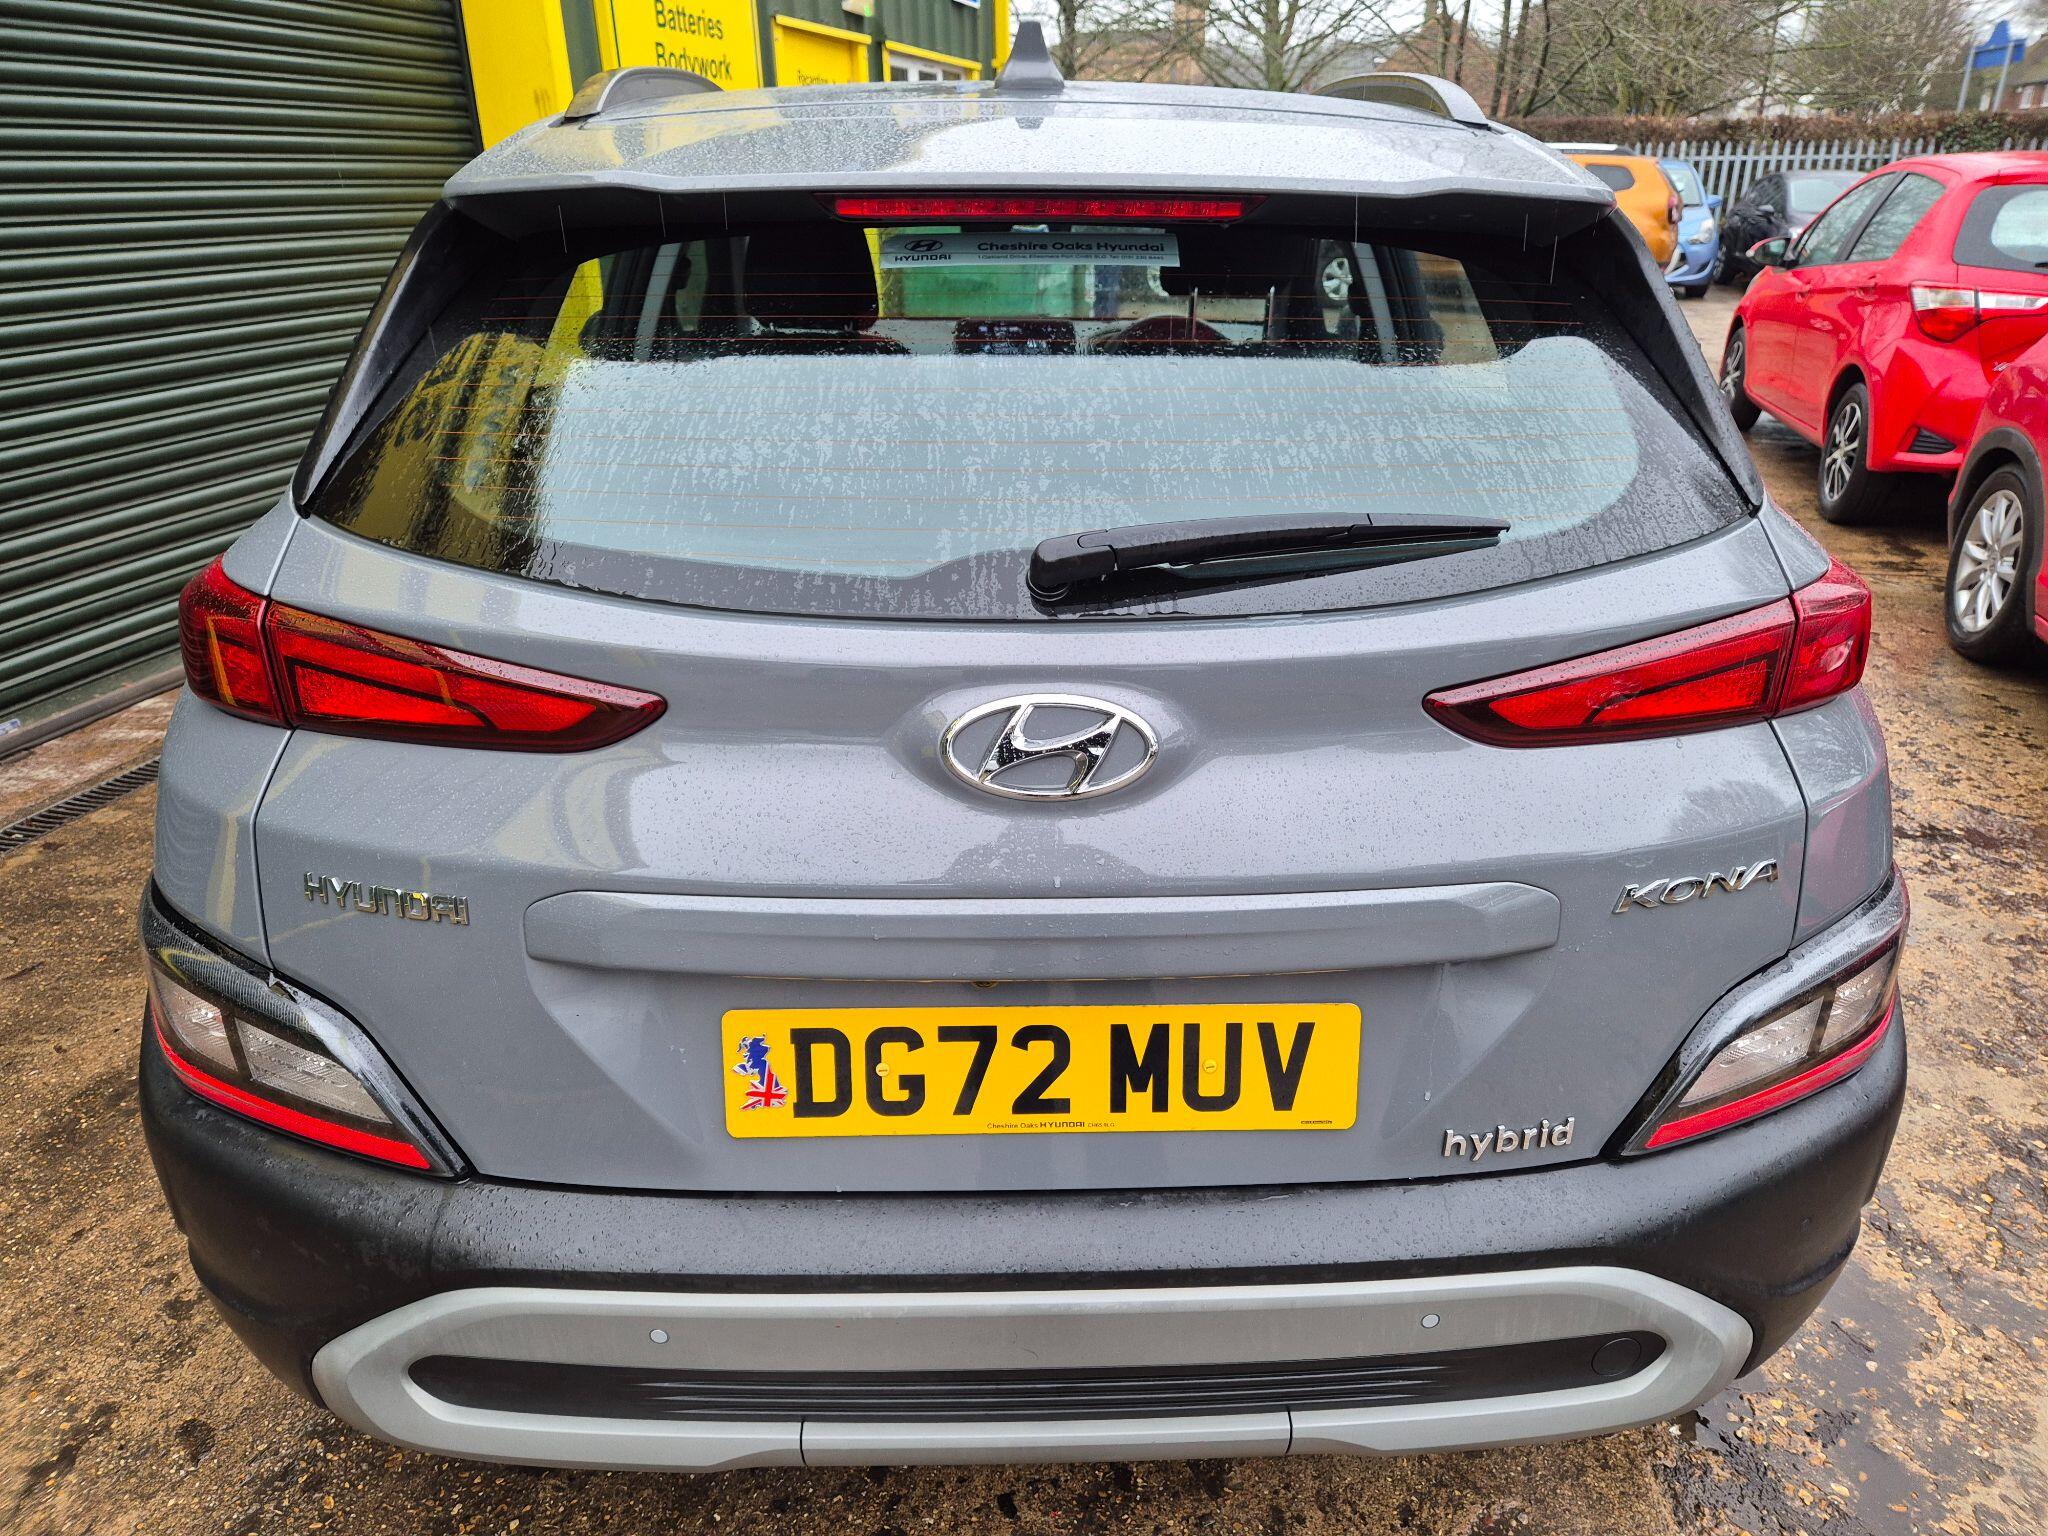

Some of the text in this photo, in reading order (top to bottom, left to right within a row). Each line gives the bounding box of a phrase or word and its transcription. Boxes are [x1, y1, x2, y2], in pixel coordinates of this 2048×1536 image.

[655, 0, 723, 40] Batteries
[655, 42, 733, 81] Bodywork
[894, 254, 952, 262] HYUNDAI
[977, 241, 1165, 252] Cheshire Oaks Hyundai
[303, 871, 470, 926] HYUNDAI
[1611, 858, 1779, 915] KONA
[788, 1021, 1316, 1119] DG72 MUV
[1442, 1116, 1576, 1161] hybrid
